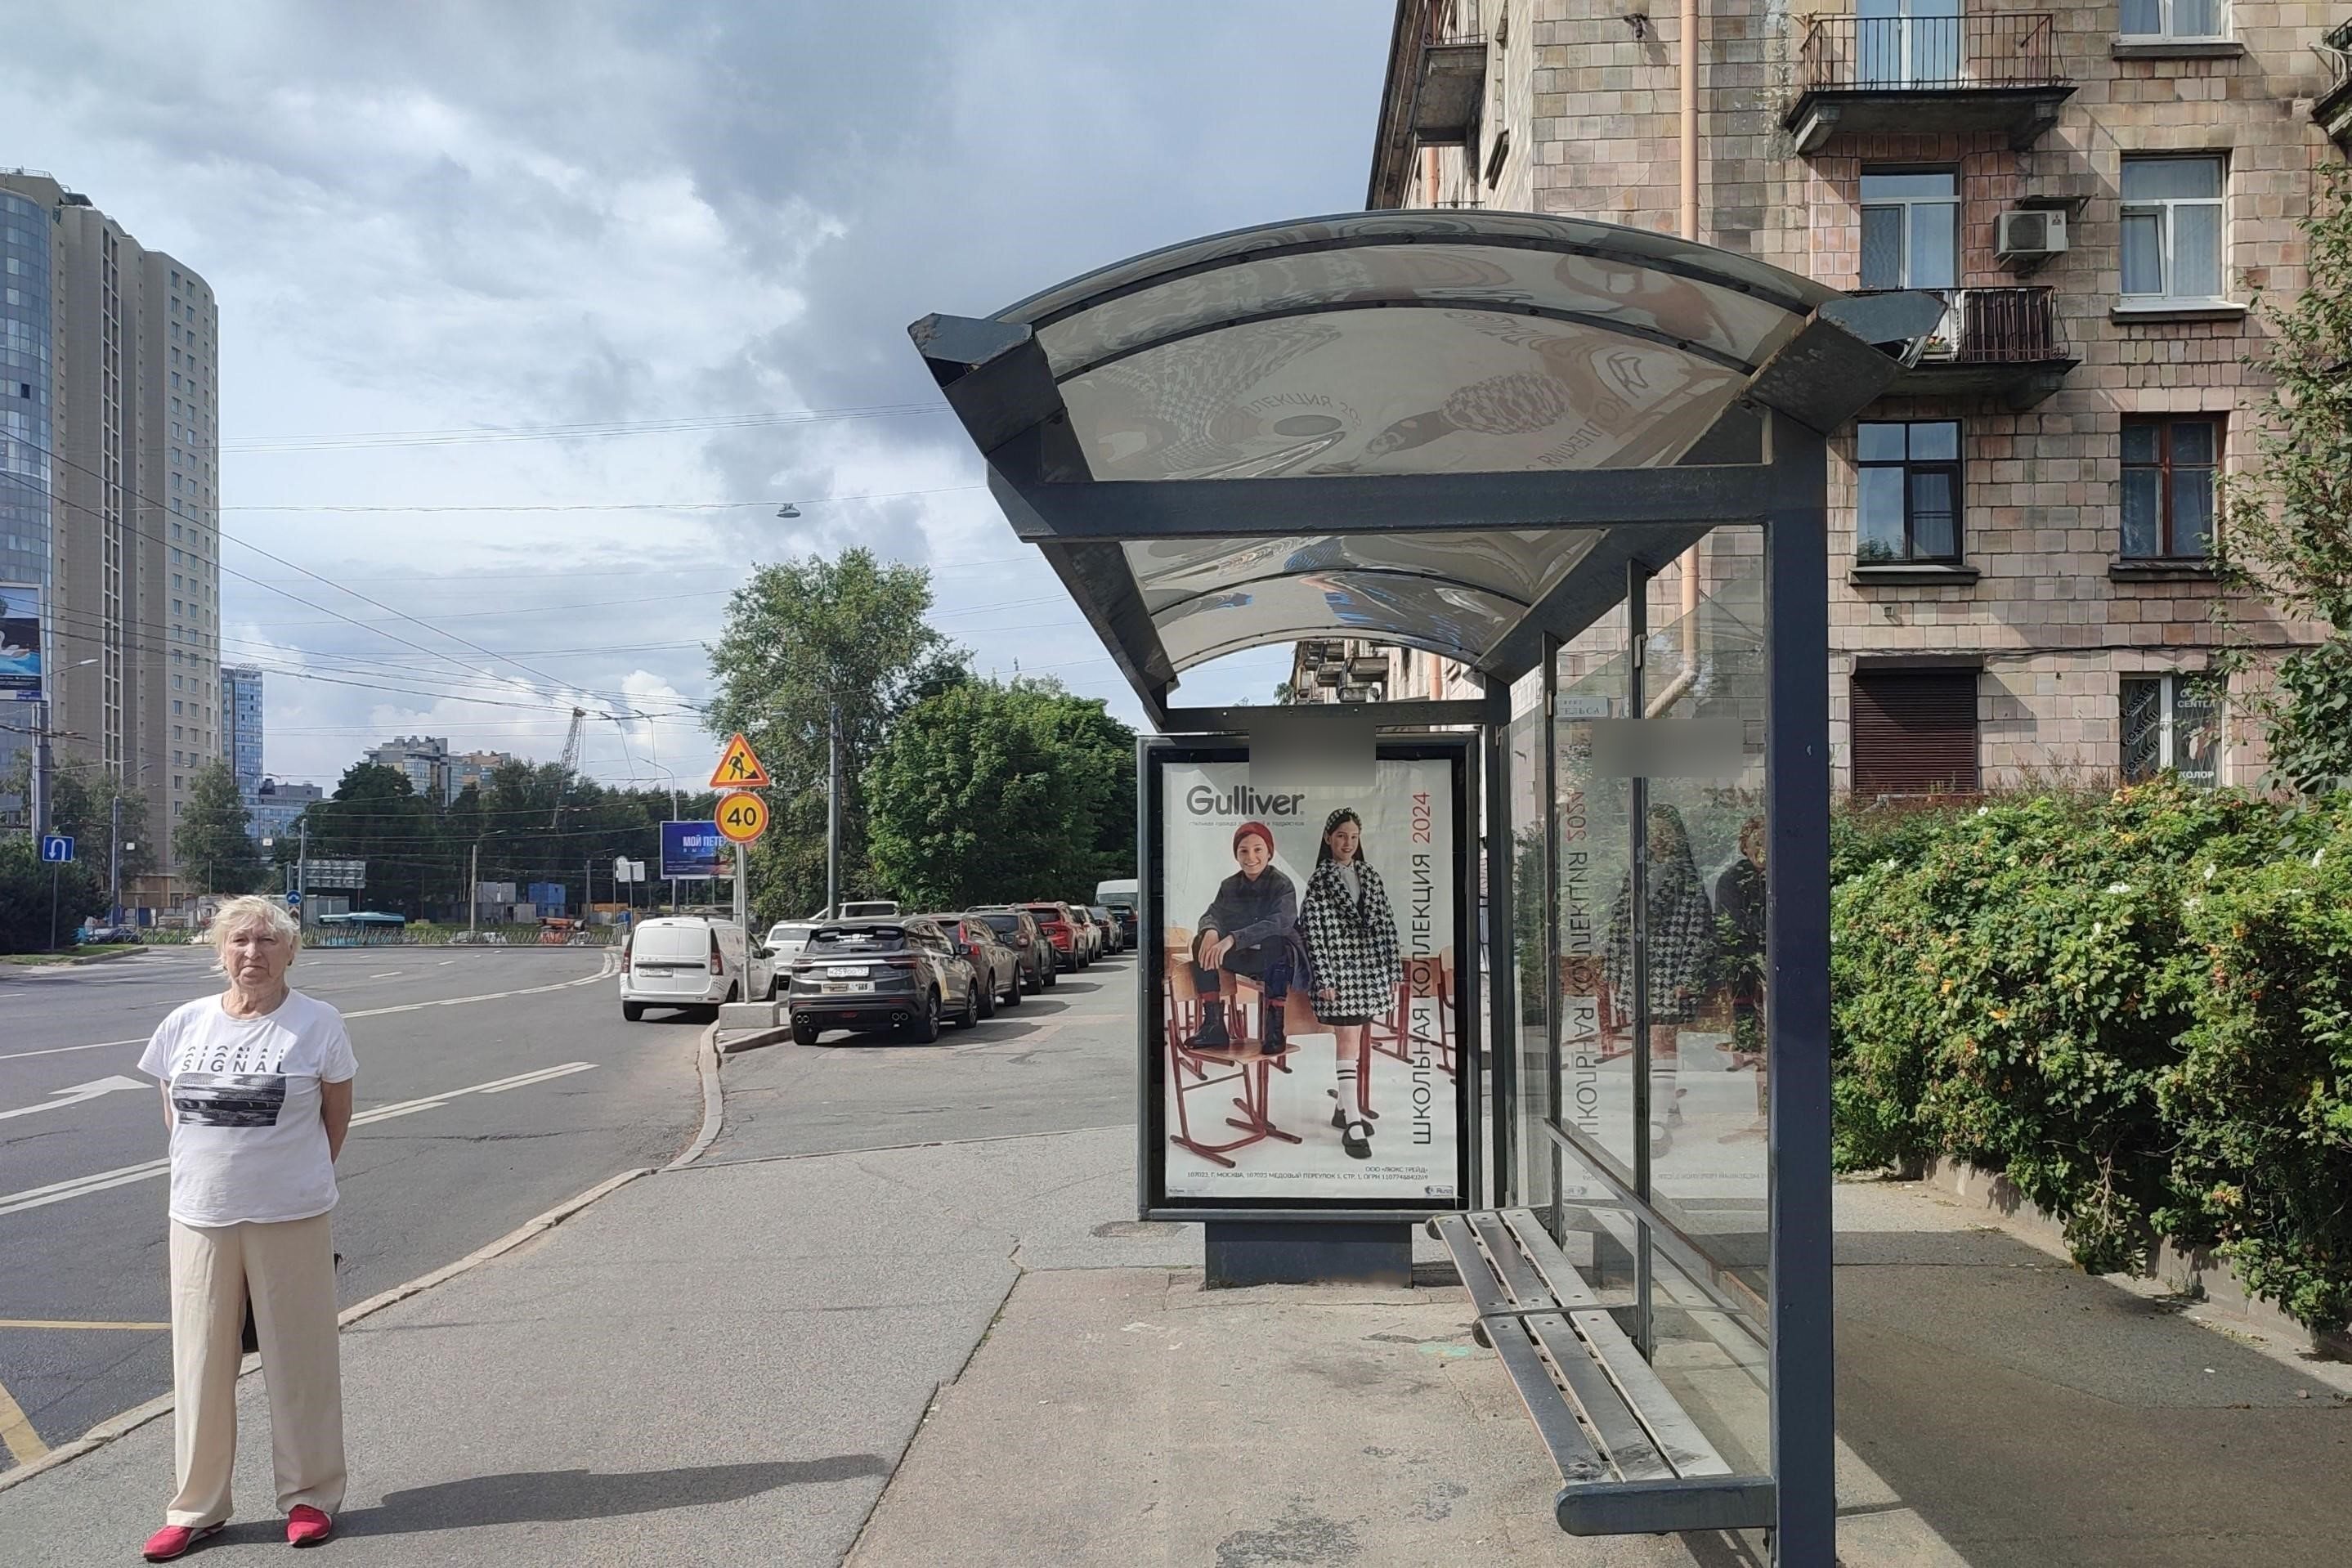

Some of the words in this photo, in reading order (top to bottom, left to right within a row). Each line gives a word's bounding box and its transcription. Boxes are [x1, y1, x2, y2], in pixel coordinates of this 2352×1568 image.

[1186, 785, 1305, 816] Gulliver
[727, 807, 757, 827] 40
[1413, 791, 1431, 844] 2024
[683, 835, 701, 847] МОЙ
[1412, 853, 1434, 999] КОЛЛЕКЦИЯ
[181, 1059, 287, 1073] SIGNAL
[1413, 1007, 1432, 1145] ШКОЛЬНАЯ
